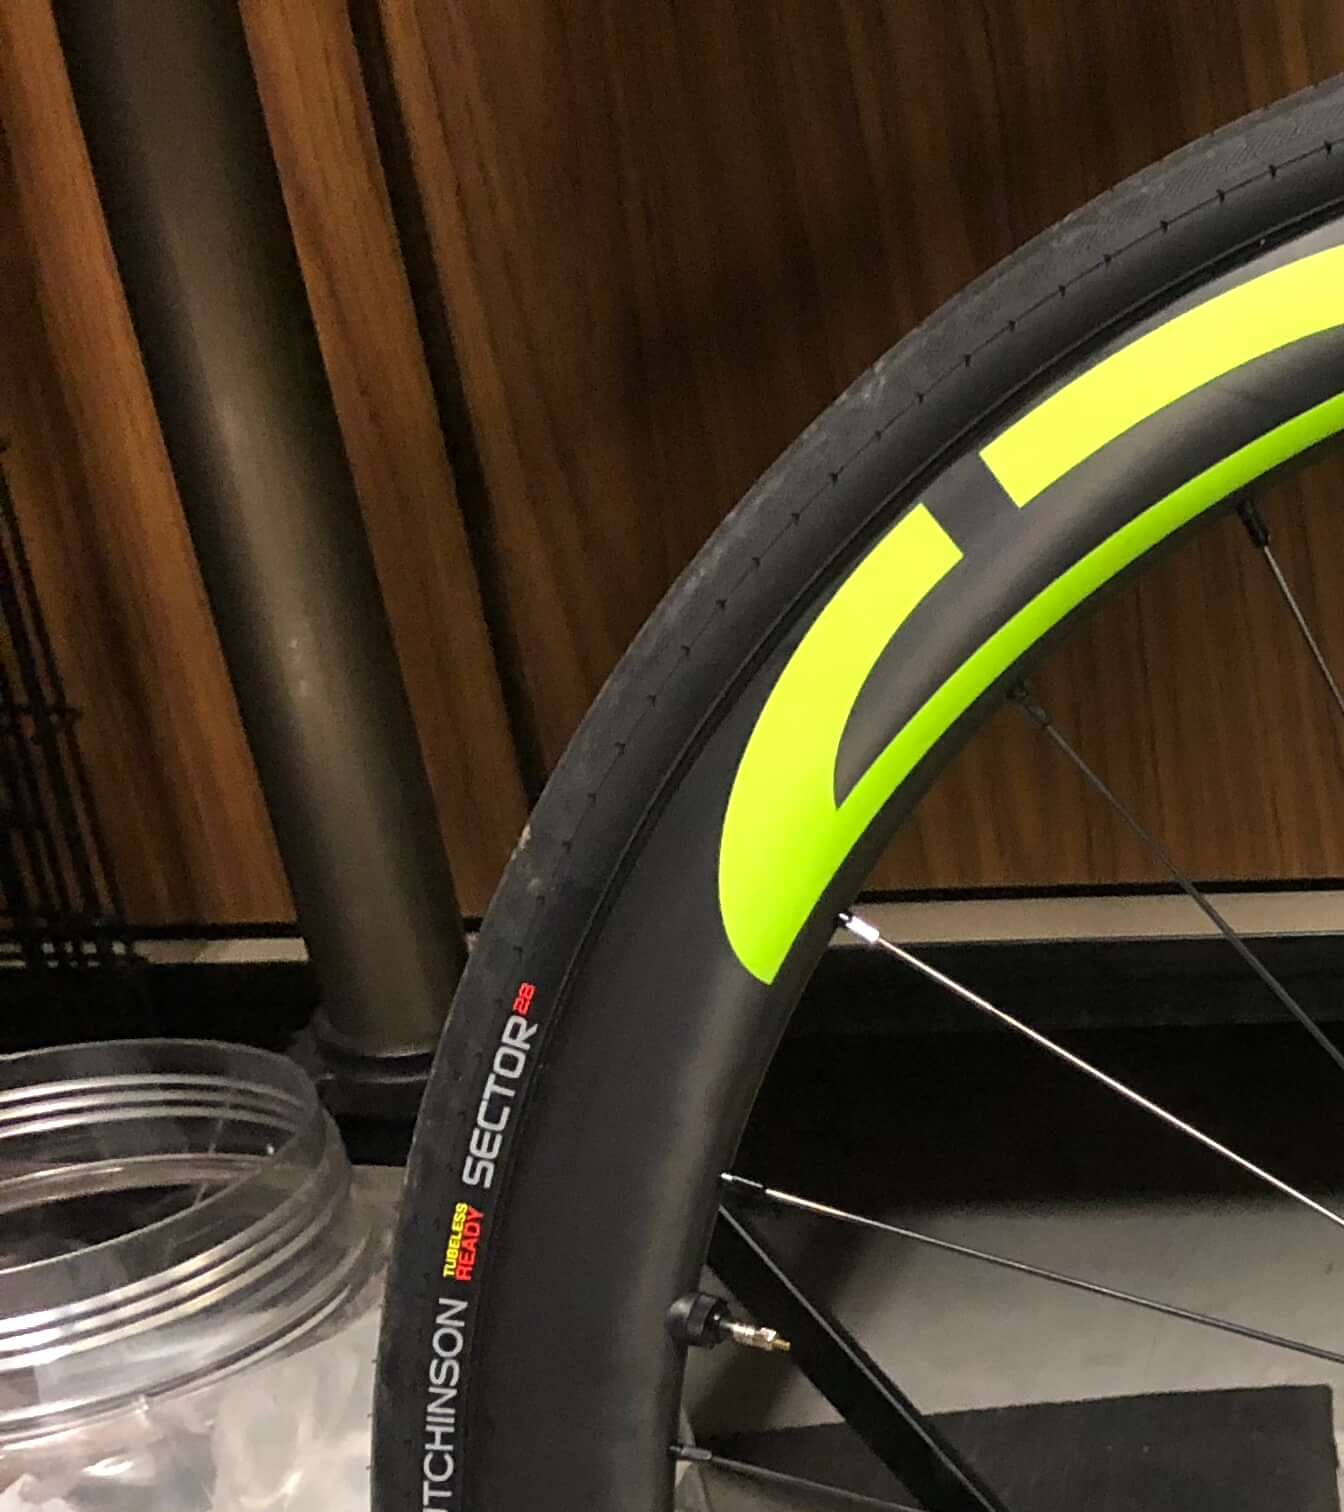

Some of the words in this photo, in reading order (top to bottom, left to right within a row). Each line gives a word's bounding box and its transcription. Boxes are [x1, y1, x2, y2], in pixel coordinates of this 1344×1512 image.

[462, 1014, 538, 1190] SECTOR
[442, 1202, 469, 1279] TUBELESS
[455, 1206, 485, 1281] READY
